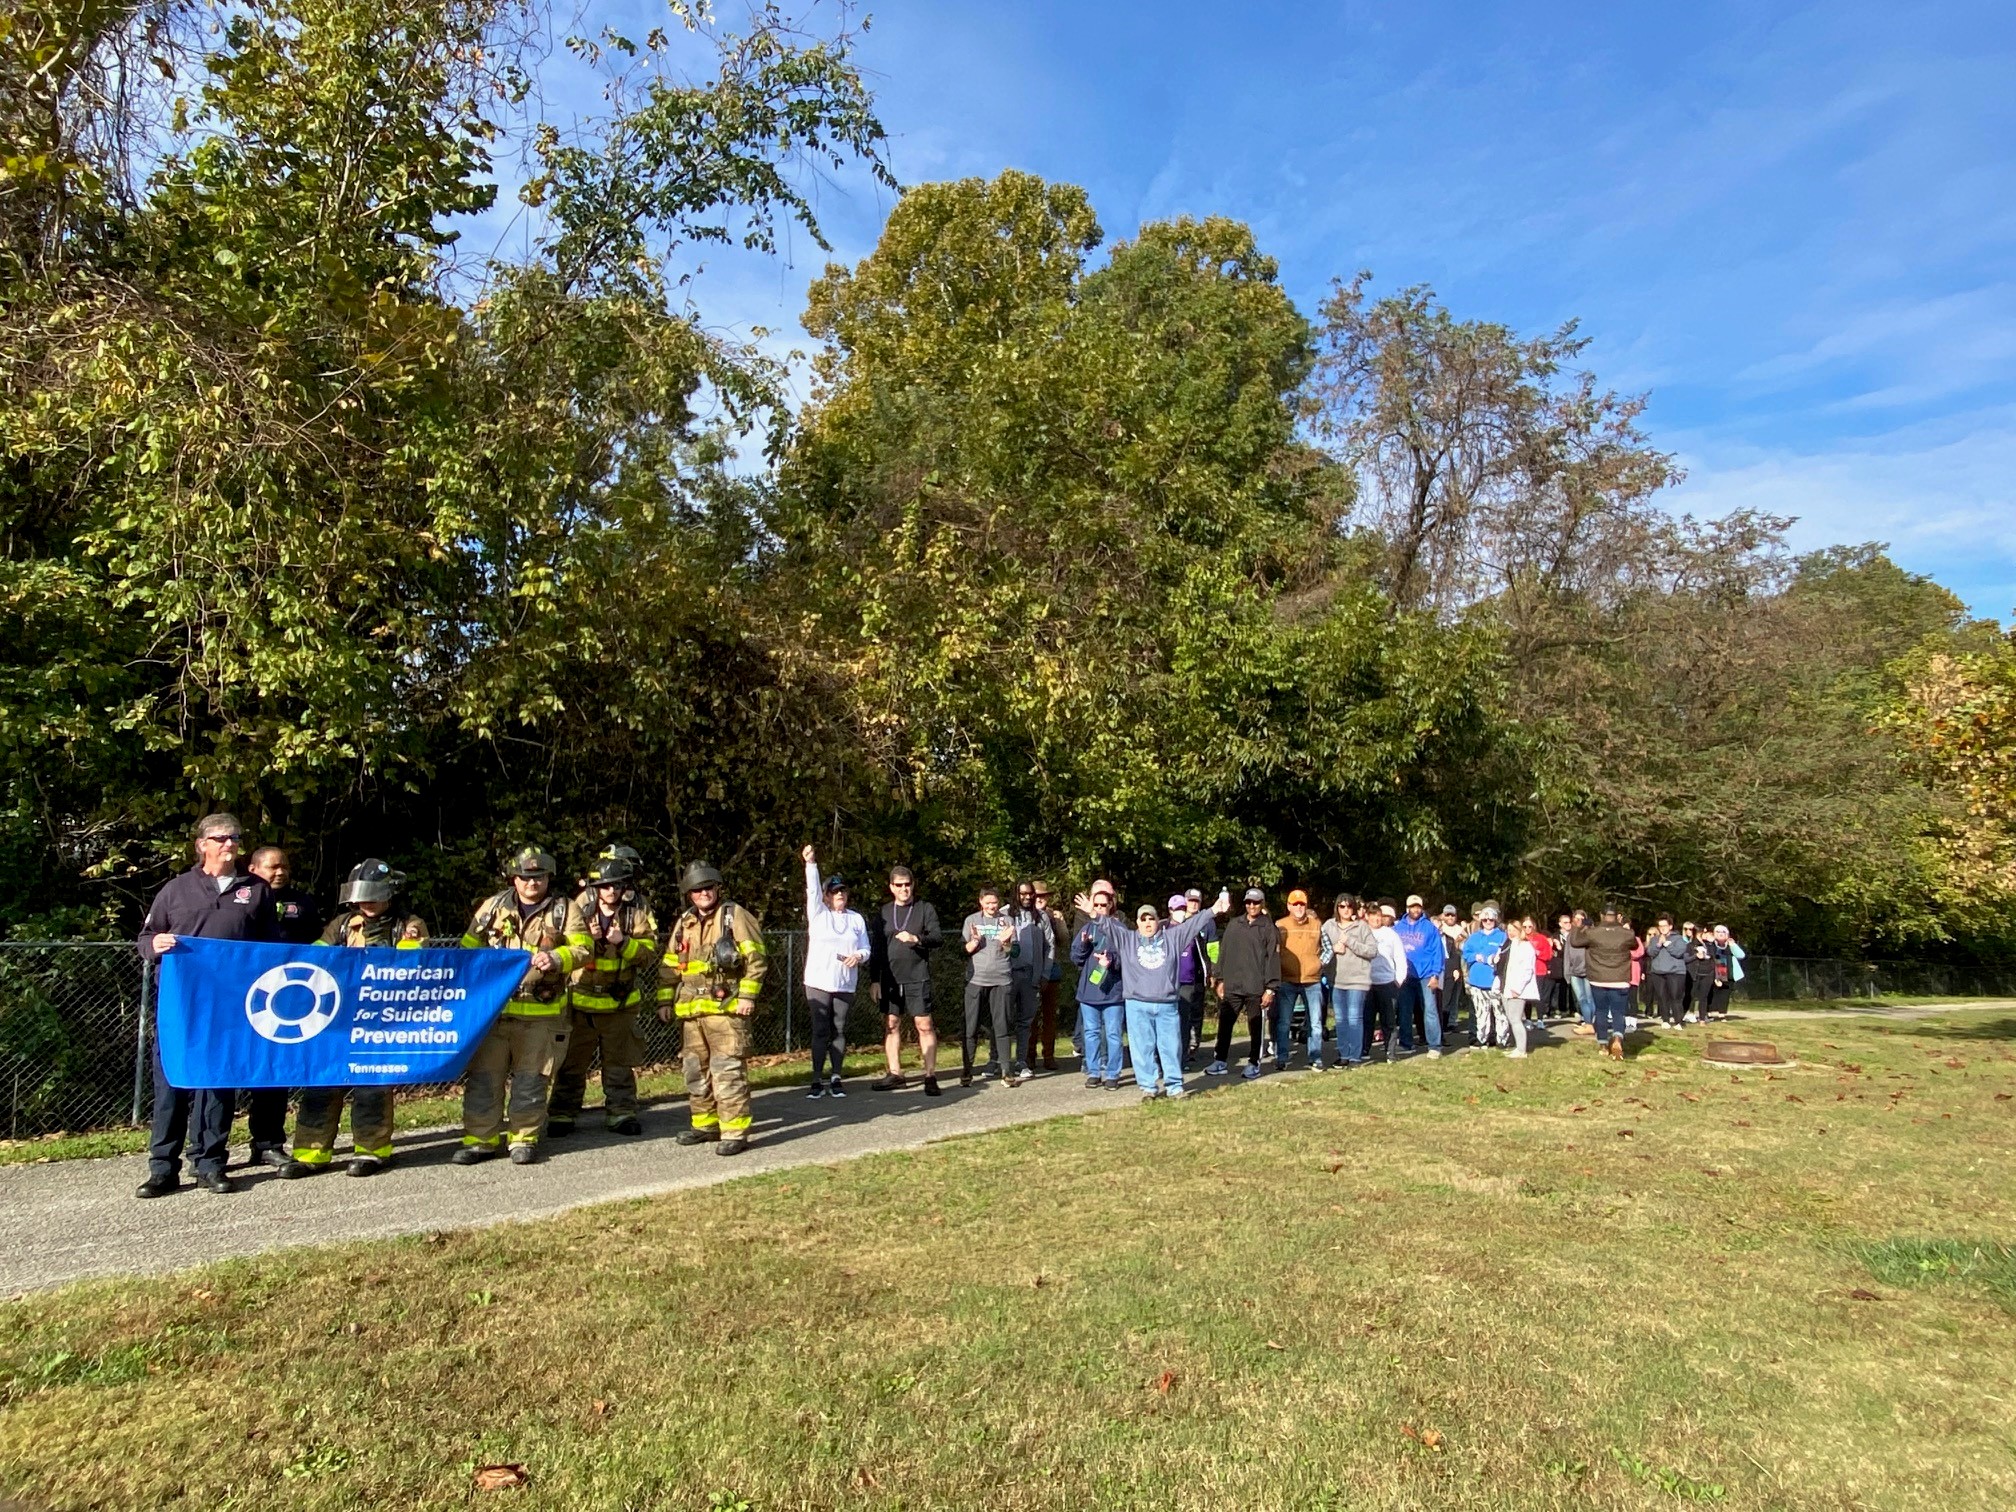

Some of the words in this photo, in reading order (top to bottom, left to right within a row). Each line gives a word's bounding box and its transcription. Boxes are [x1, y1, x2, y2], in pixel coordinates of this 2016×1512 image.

[360, 963, 455, 981] American
[358, 985, 467, 1002] Foundation
[353, 1009, 378, 1022] for
[380, 1005, 454, 1023] Suicide
[350, 1026, 459, 1045] Prevention
[348, 1062, 409, 1074] Tennessee
